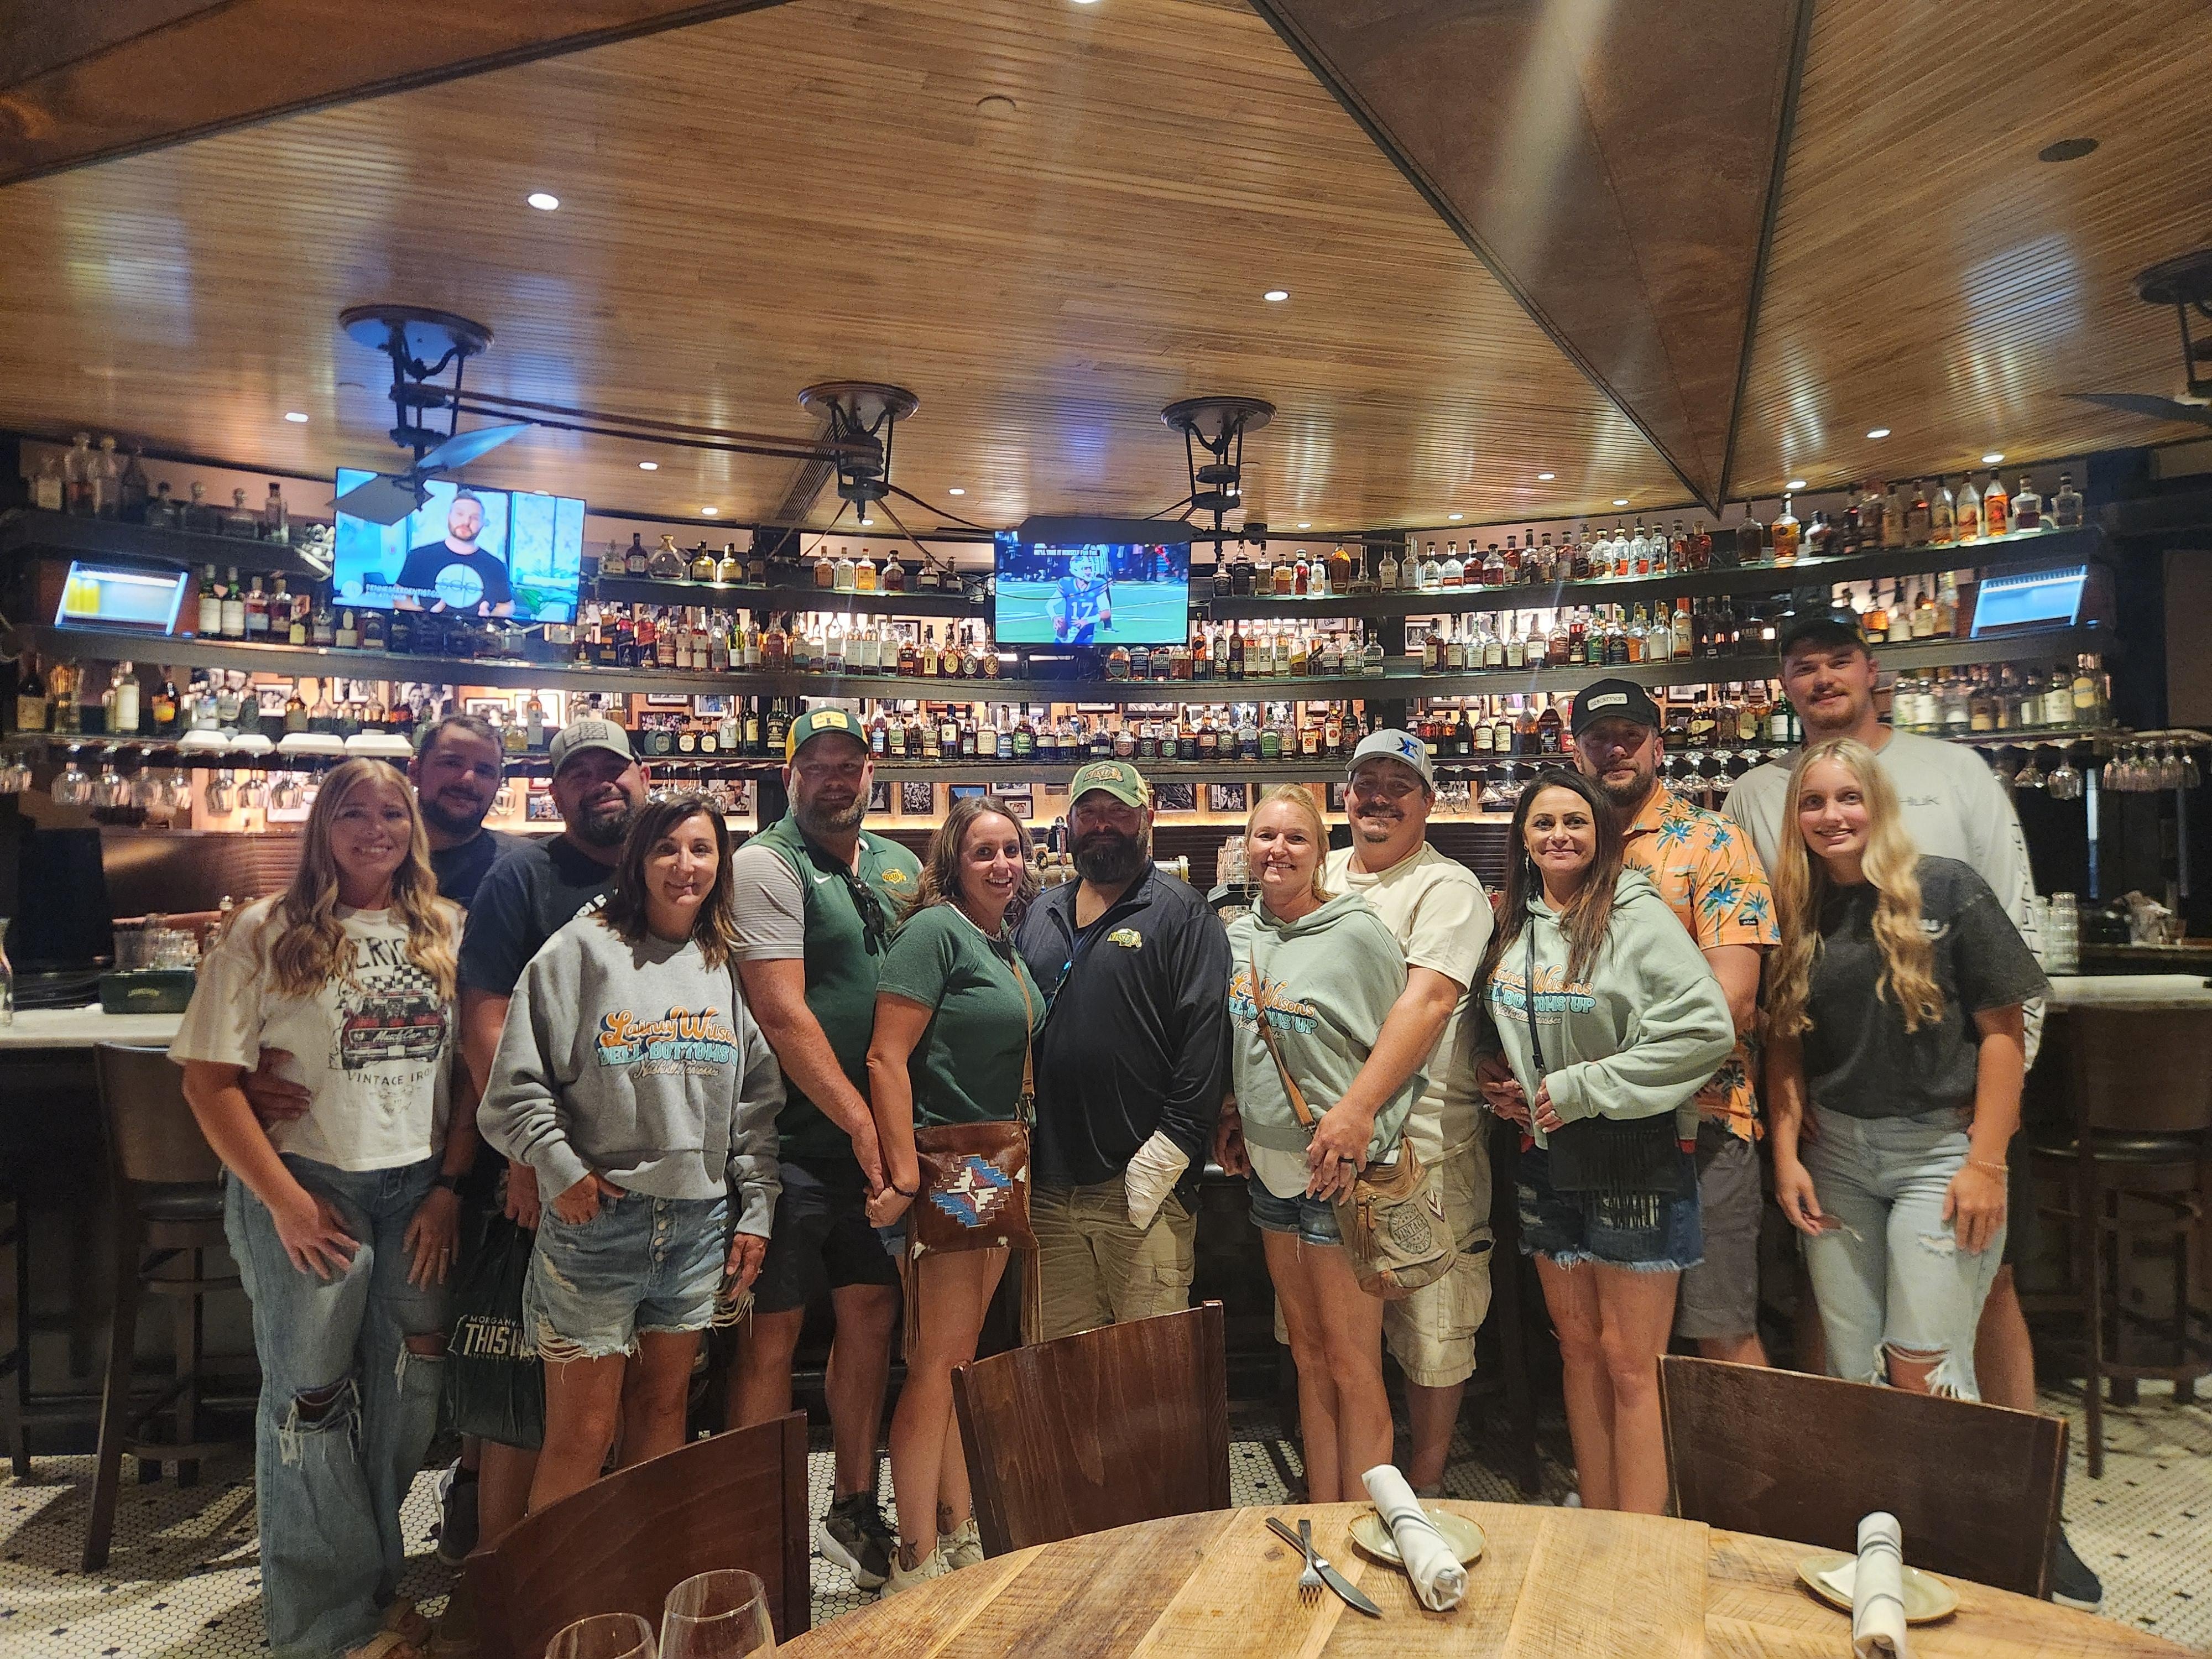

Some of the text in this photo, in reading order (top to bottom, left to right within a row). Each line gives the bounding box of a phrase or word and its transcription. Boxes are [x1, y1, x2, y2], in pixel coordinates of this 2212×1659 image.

[1071, 601, 1094, 620] 17
[1087, 769, 1110, 779] NDSU
[1569, 996, 1597, 1014] UP
[594, 1009, 678, 1049] Lainey
[1295, 1016, 1319, 1035] UP
[598, 1042, 645, 1066] BELL
[648, 1041, 730, 1065] BOTTOMS
[347, 1070, 404, 1086] VINTAGE
[1394, 1216, 1427, 1241] VINTAGE
[470, 1316, 511, 1328] MORGAN
[463, 1323, 510, 1355] THIS
